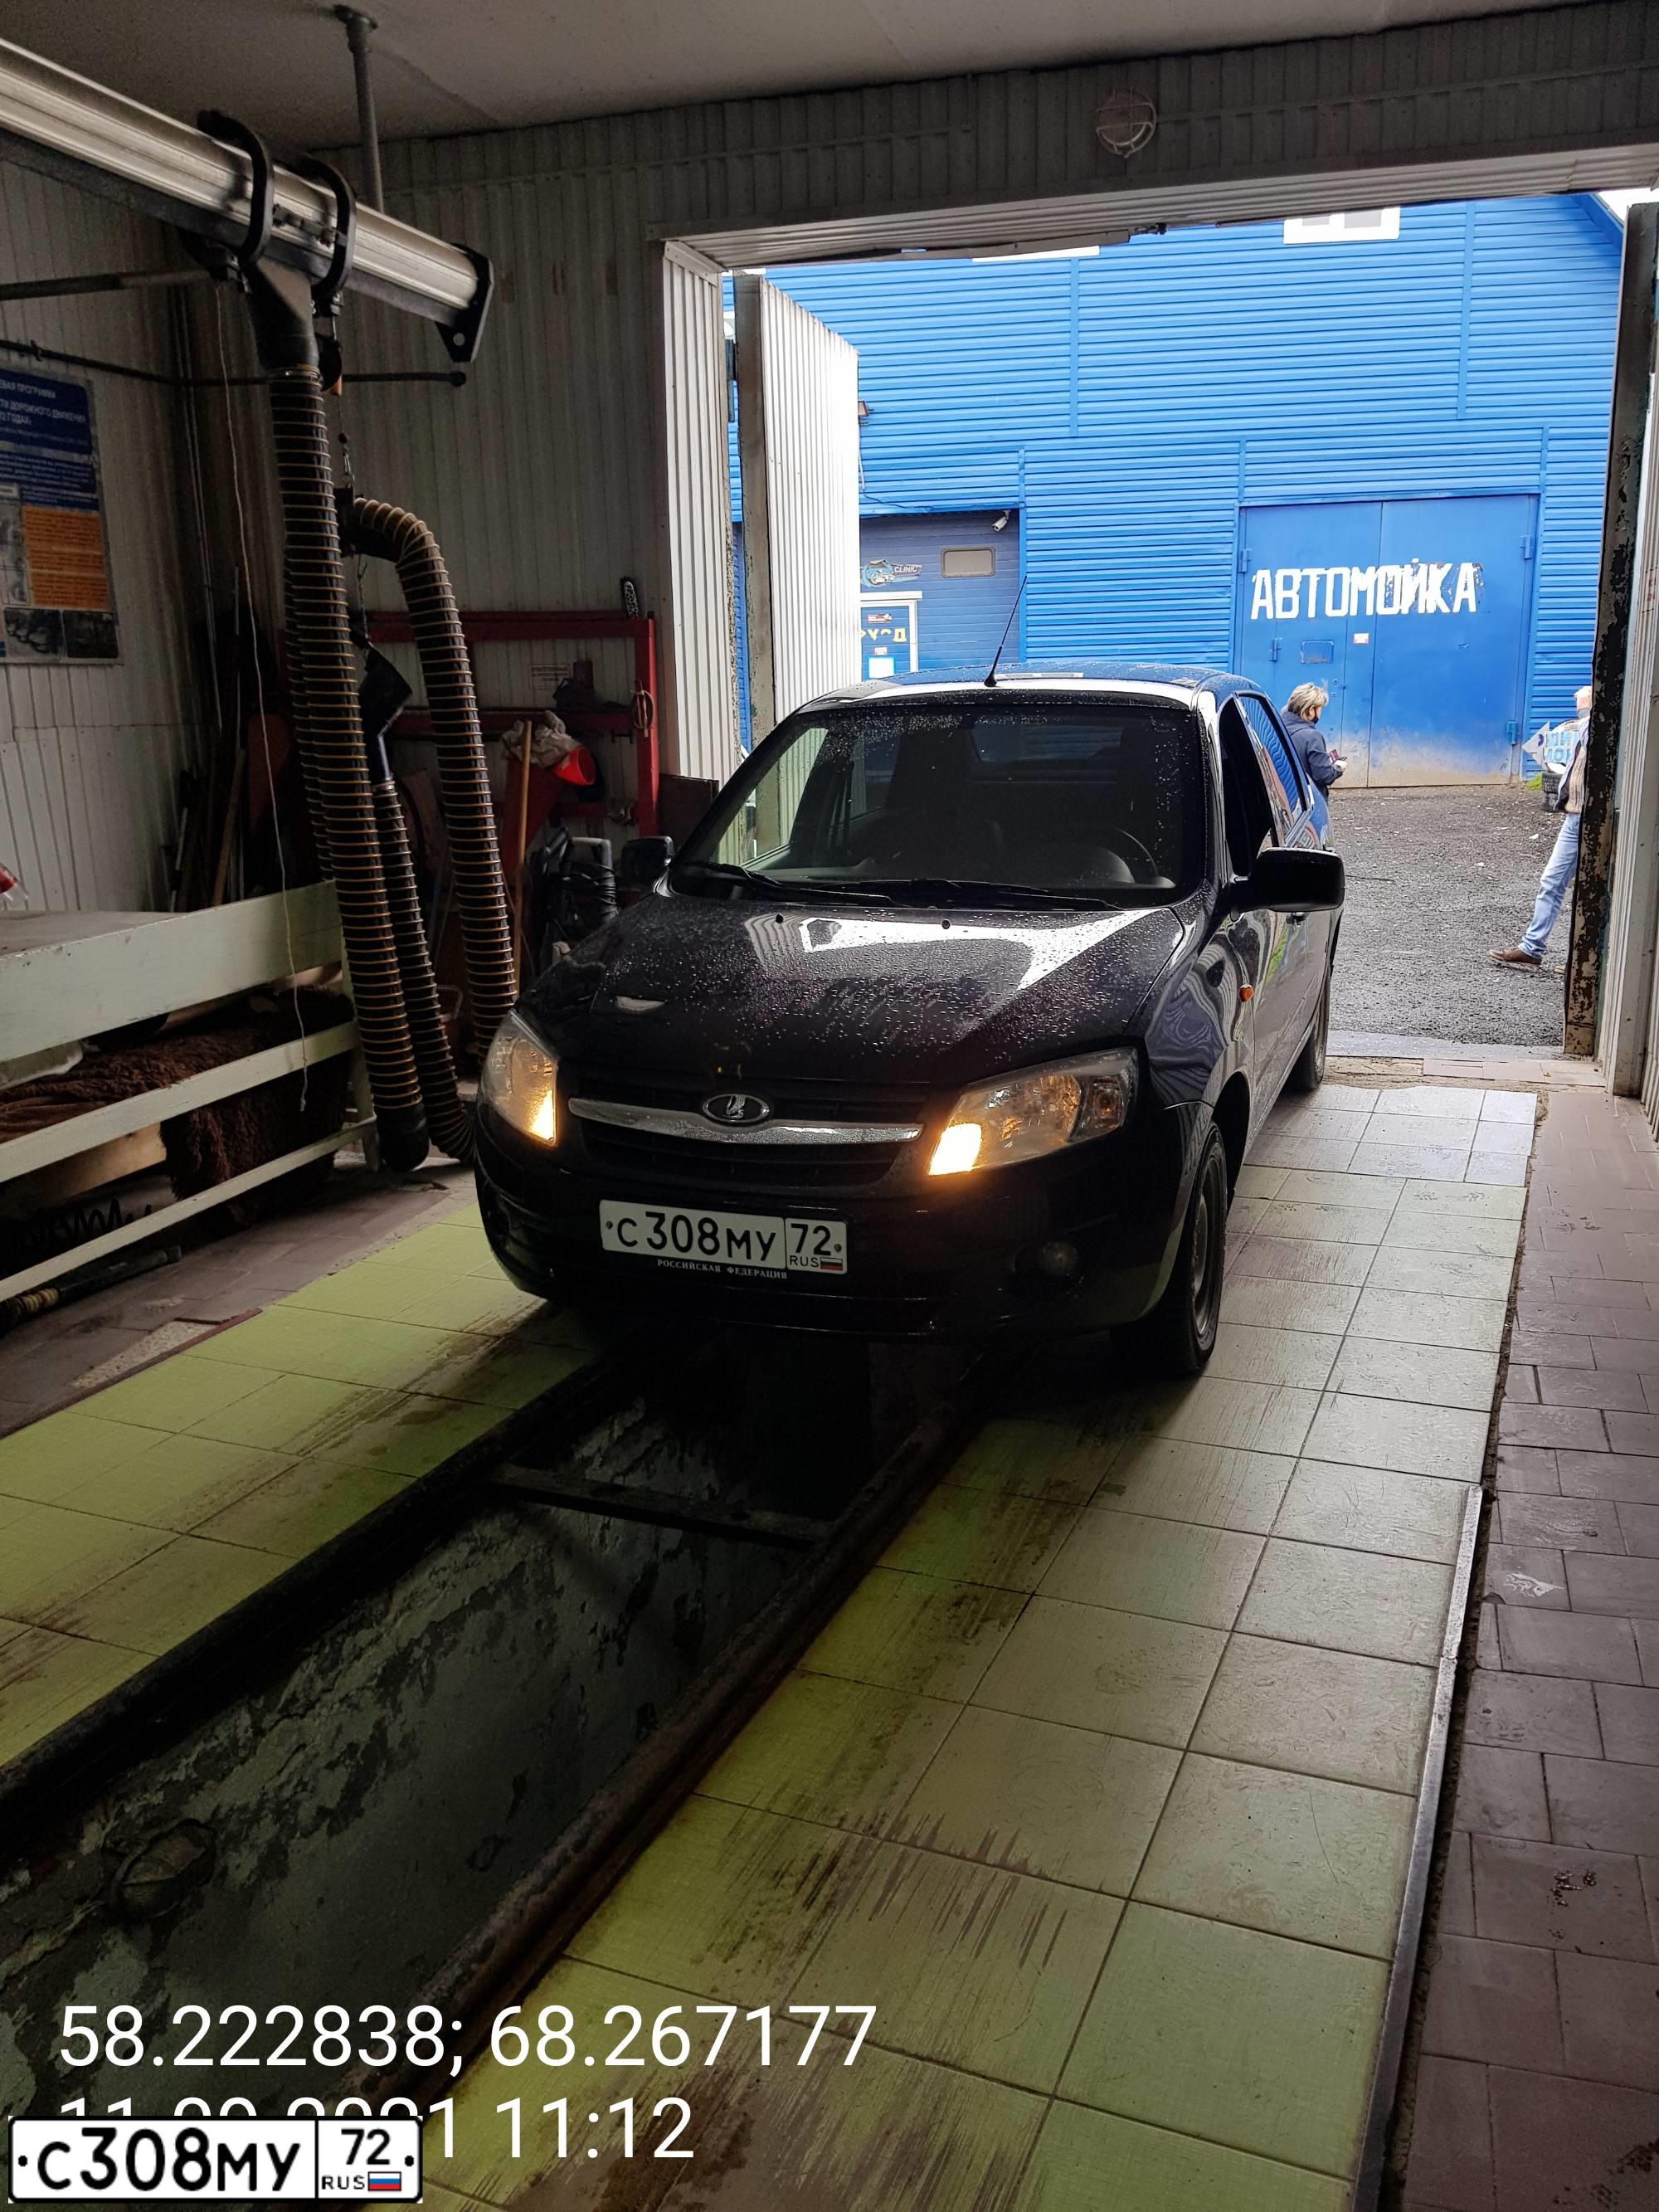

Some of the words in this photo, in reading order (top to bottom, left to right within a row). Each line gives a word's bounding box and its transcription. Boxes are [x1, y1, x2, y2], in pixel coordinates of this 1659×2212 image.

[1250, 558, 1477, 620] АВТОМОЙКА
[617, 1211, 776, 1261] С308МУ
[791, 1223, 832, 1257] 72
[657, 1259, 721, 1273] РОССИЙСКАЯ
[726, 1266, 787, 1279] ФЕДЕРАЦИЯ
[790, 1255, 820, 1268] RUS
